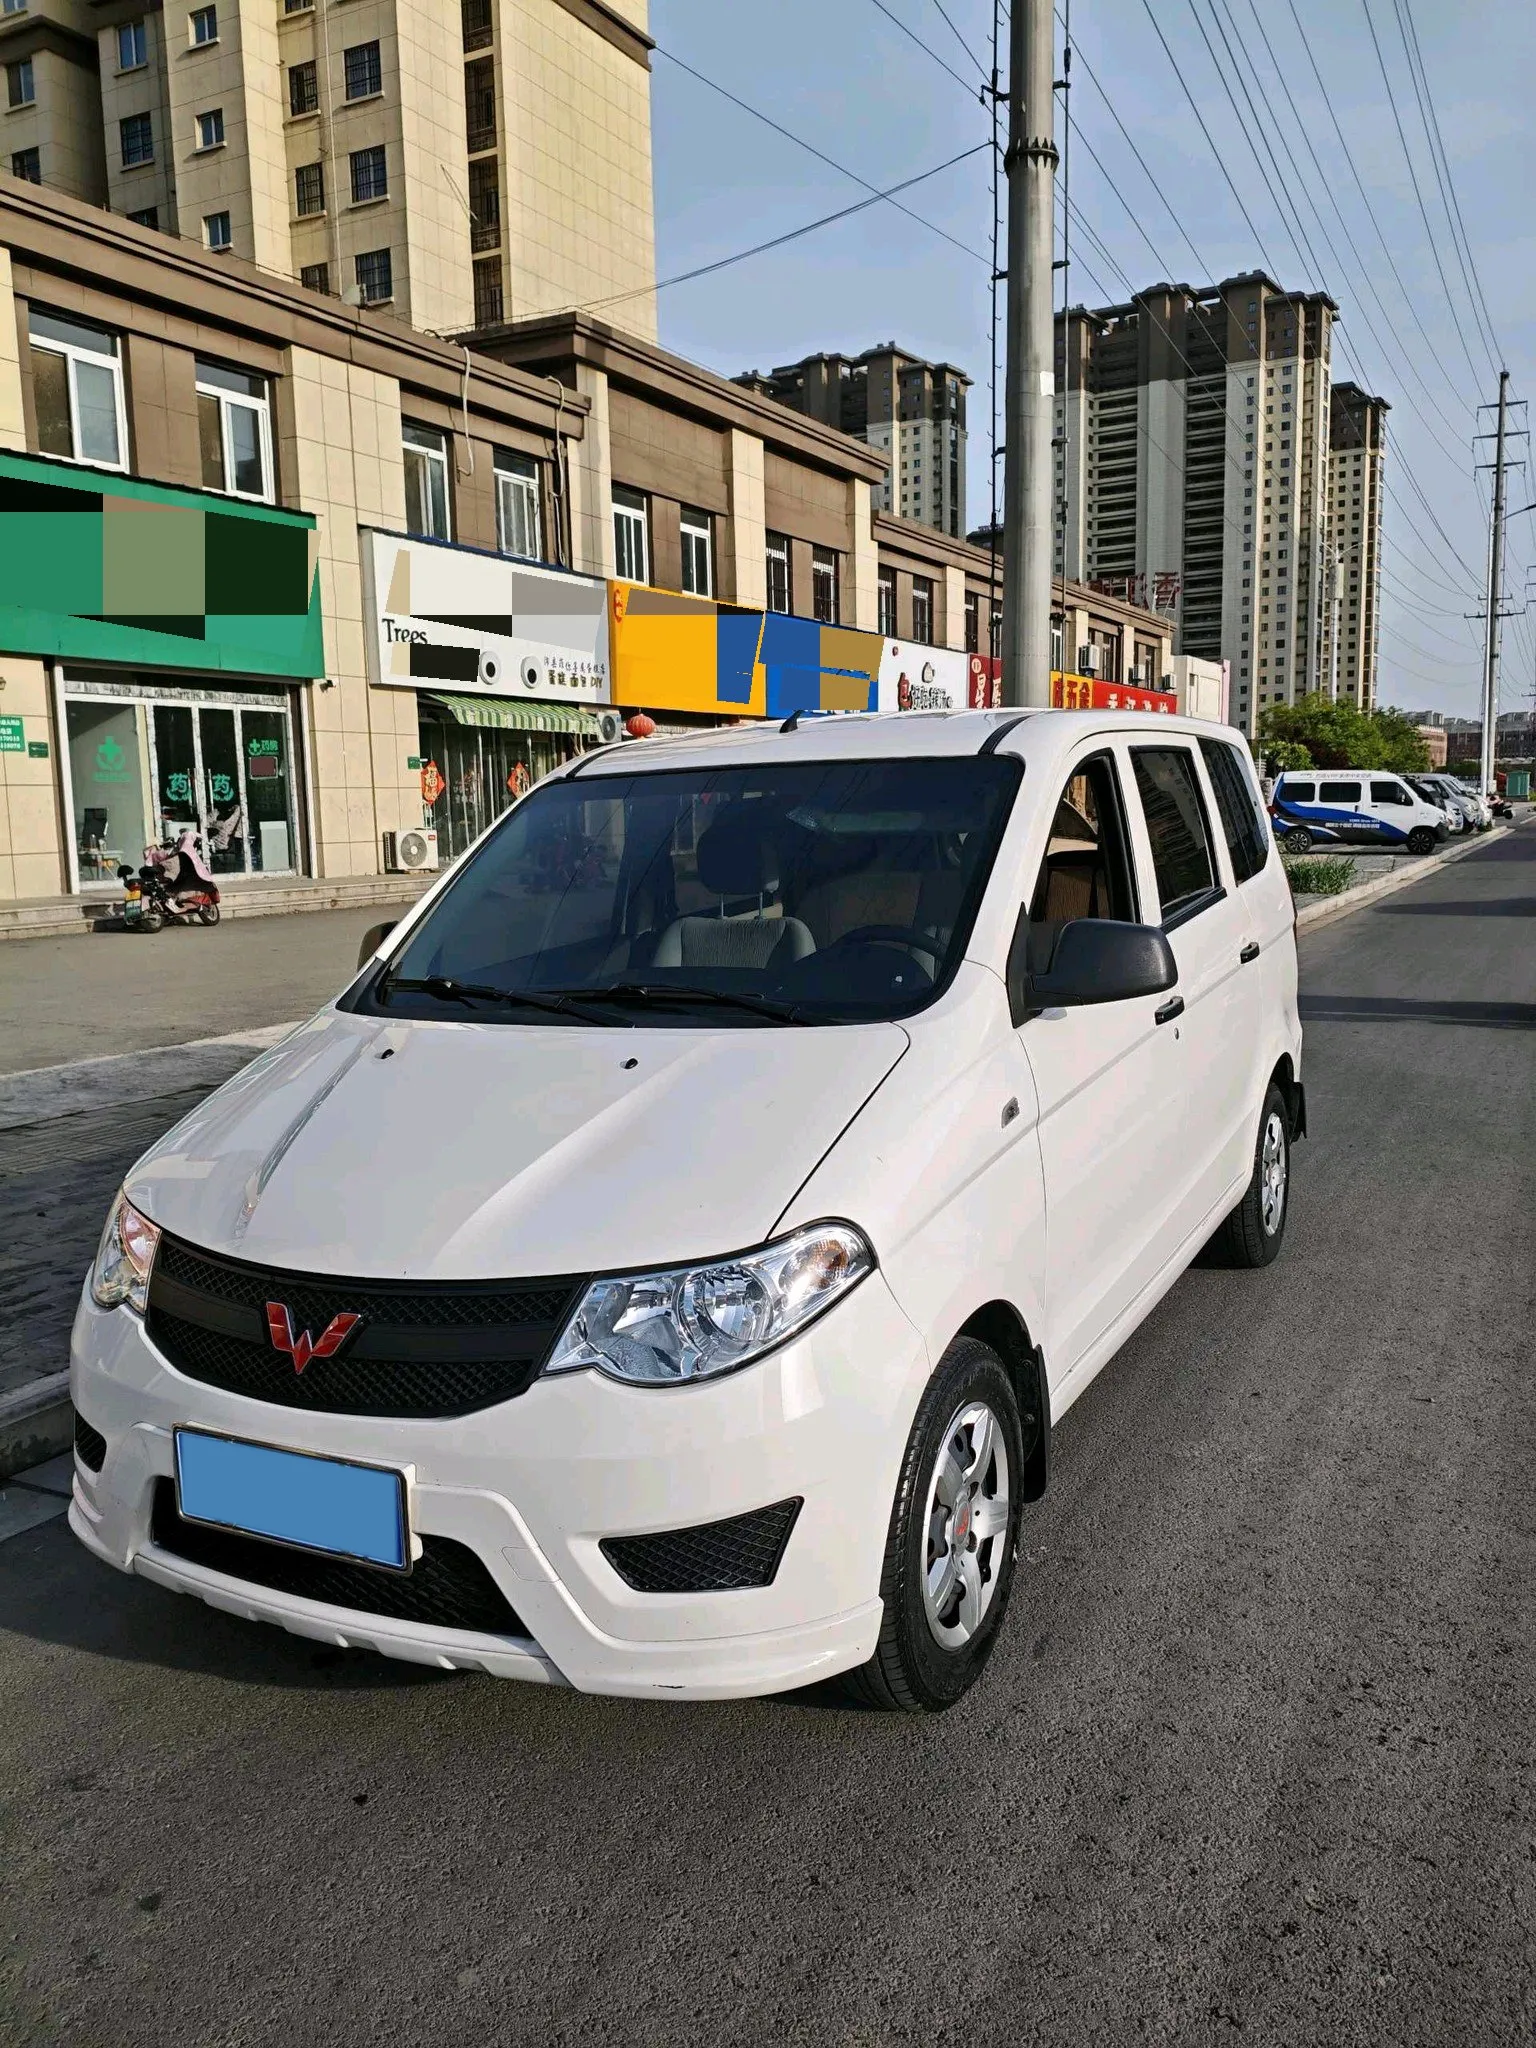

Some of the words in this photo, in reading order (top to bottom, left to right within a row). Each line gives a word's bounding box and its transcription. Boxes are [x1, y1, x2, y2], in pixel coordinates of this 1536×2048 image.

[382, 618, 428, 645] Trees
[168, 773, 188, 793] 药
[212, 773, 231, 794] 药
